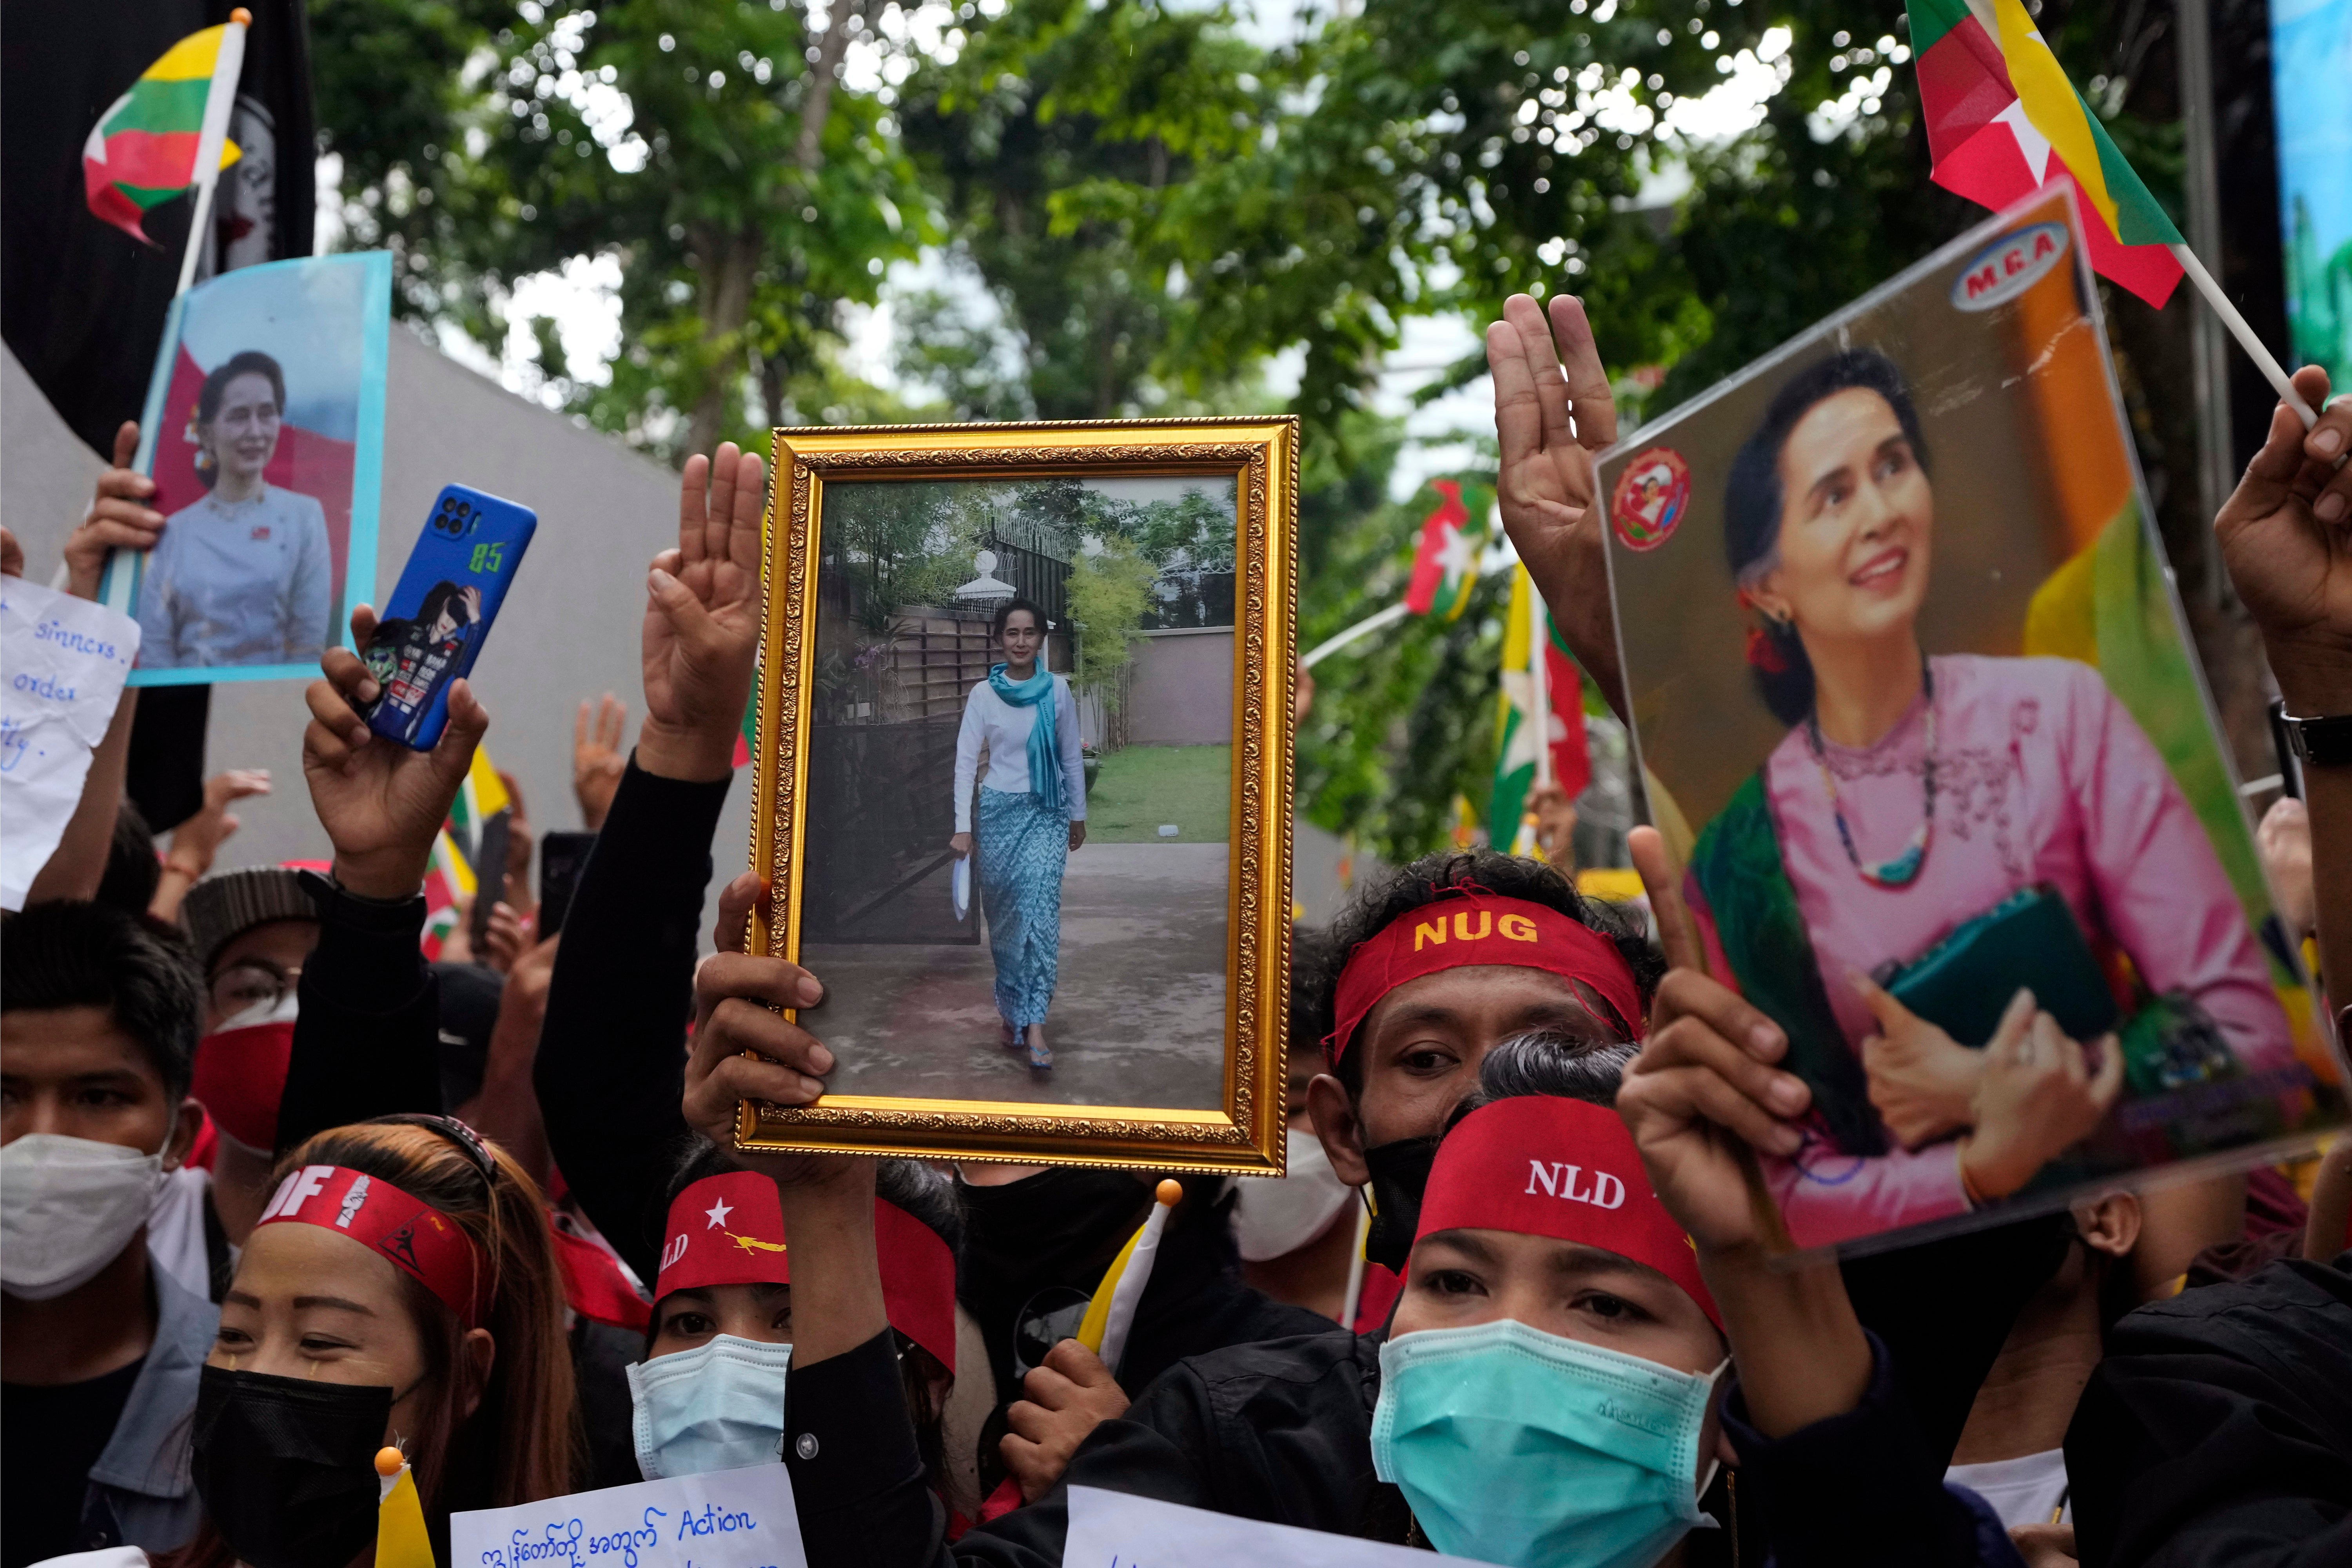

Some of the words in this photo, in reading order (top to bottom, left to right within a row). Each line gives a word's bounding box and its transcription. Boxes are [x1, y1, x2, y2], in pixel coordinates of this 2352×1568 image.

[469, 542, 506, 574] 85
[14, 673, 76, 702] order
[1415, 911, 1538, 952] NUG
[1525, 1160, 1625, 1209] NLD
[679, 1504, 756, 1541] Action
